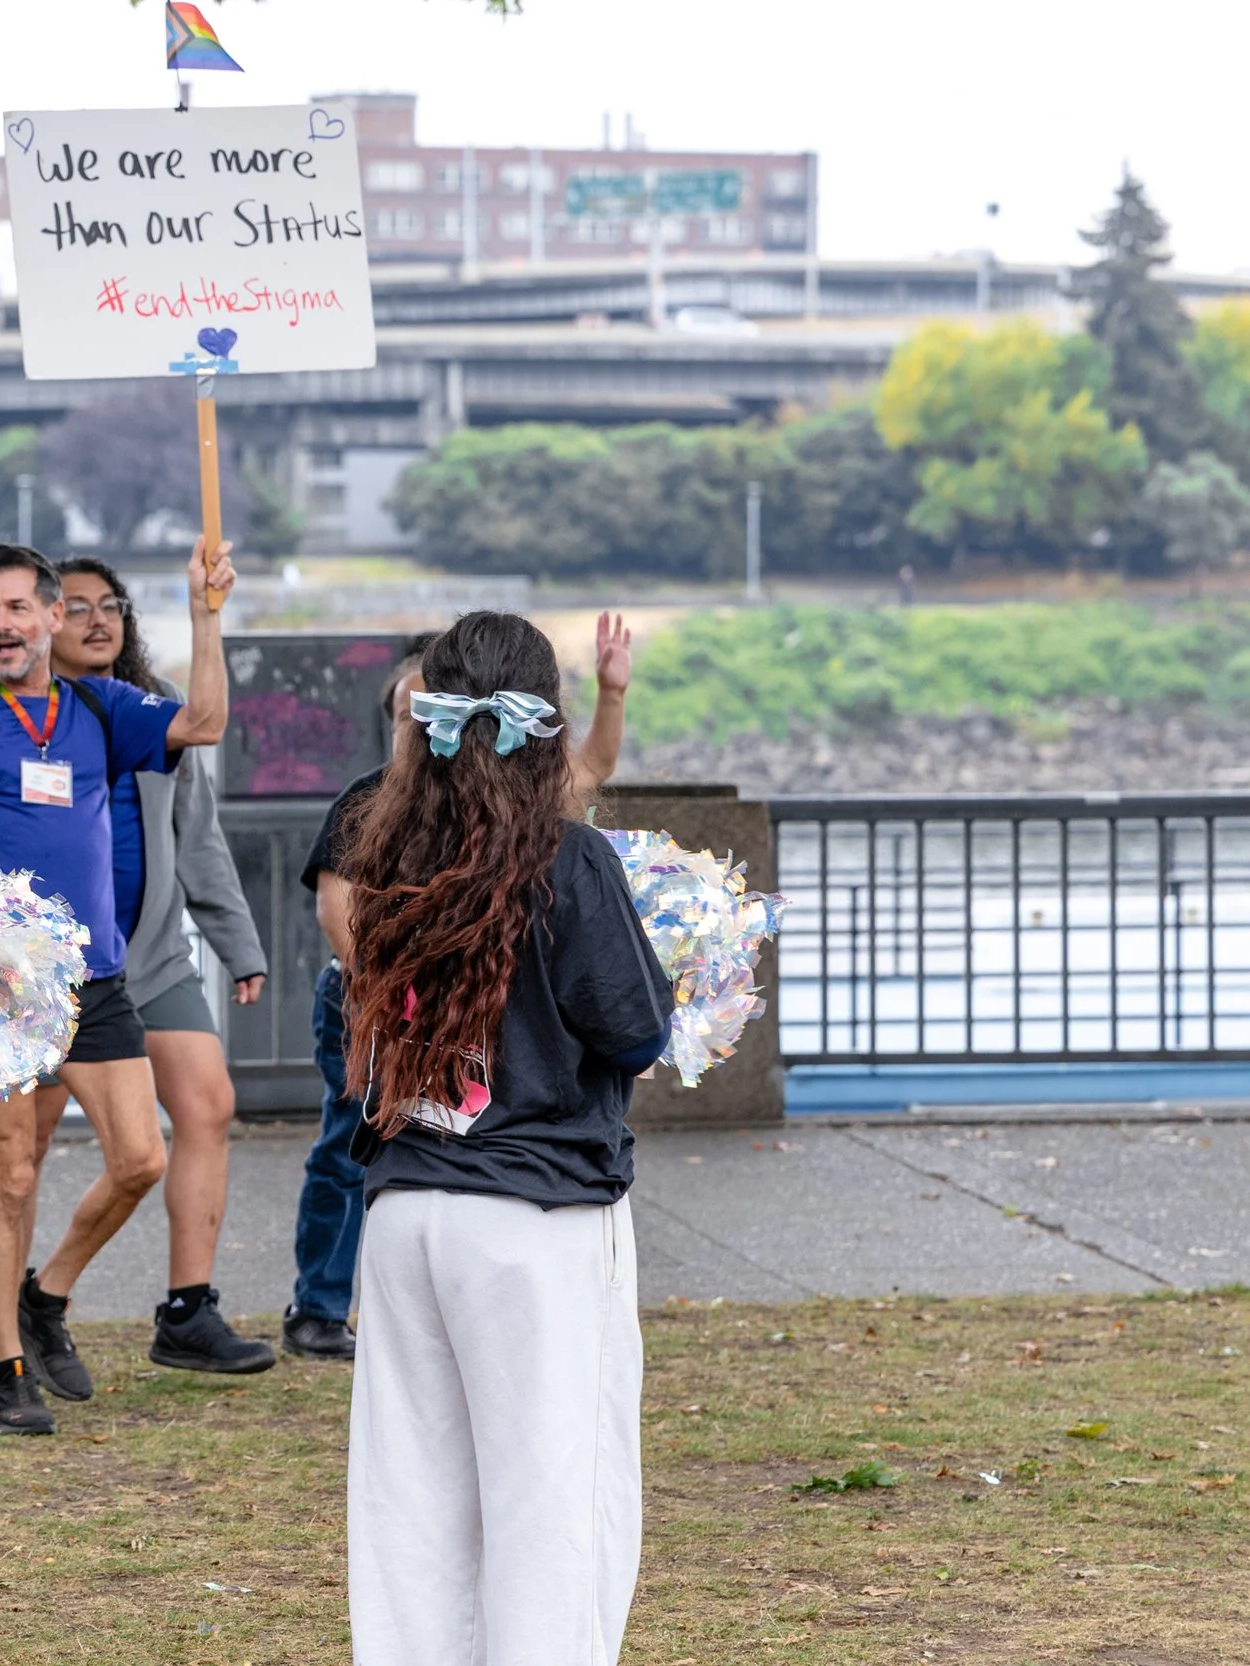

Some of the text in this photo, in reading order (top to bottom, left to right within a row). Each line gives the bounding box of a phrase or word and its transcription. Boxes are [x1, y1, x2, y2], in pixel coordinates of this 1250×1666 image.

[36, 143, 317, 183] We are more
[41, 200, 127, 251] than
[146, 209, 213, 245] our
[97, 276, 344, 327] #endtheStigma
